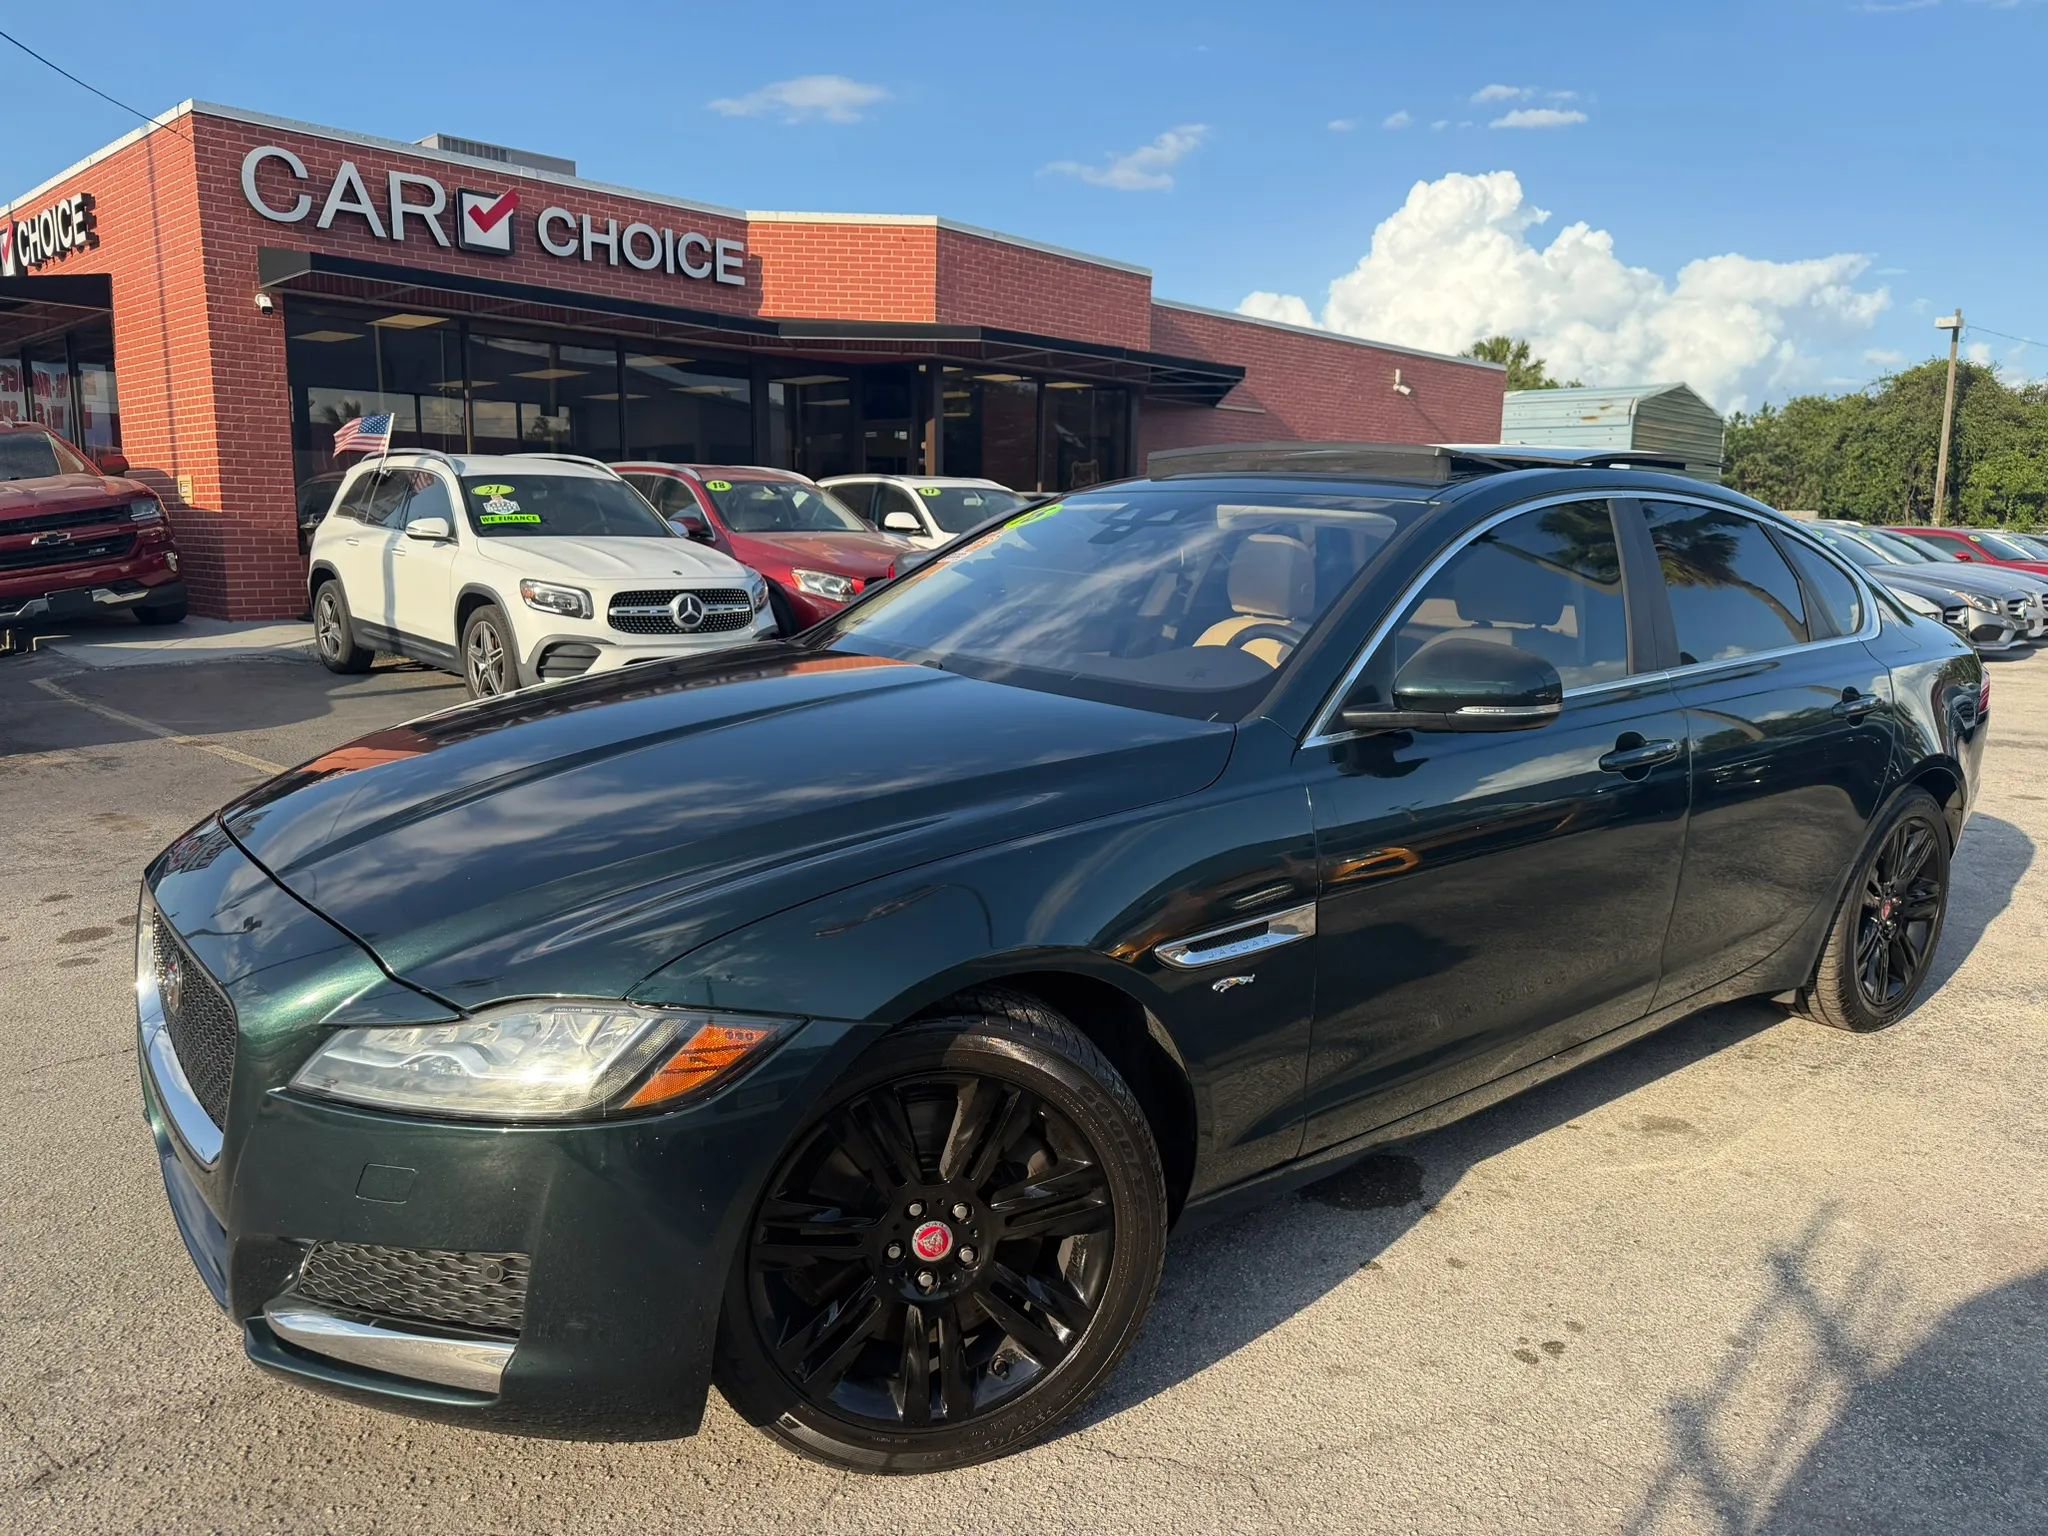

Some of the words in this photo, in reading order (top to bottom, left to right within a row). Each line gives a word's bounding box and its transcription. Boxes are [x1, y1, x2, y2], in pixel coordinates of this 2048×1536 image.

[17, 192, 87, 267] CHOICE
[241, 145, 451, 247] CAR
[537, 206, 746, 286] CHOICE
[485, 485, 500, 494] 21
[1208, 936, 1271, 959] JAGUAR
